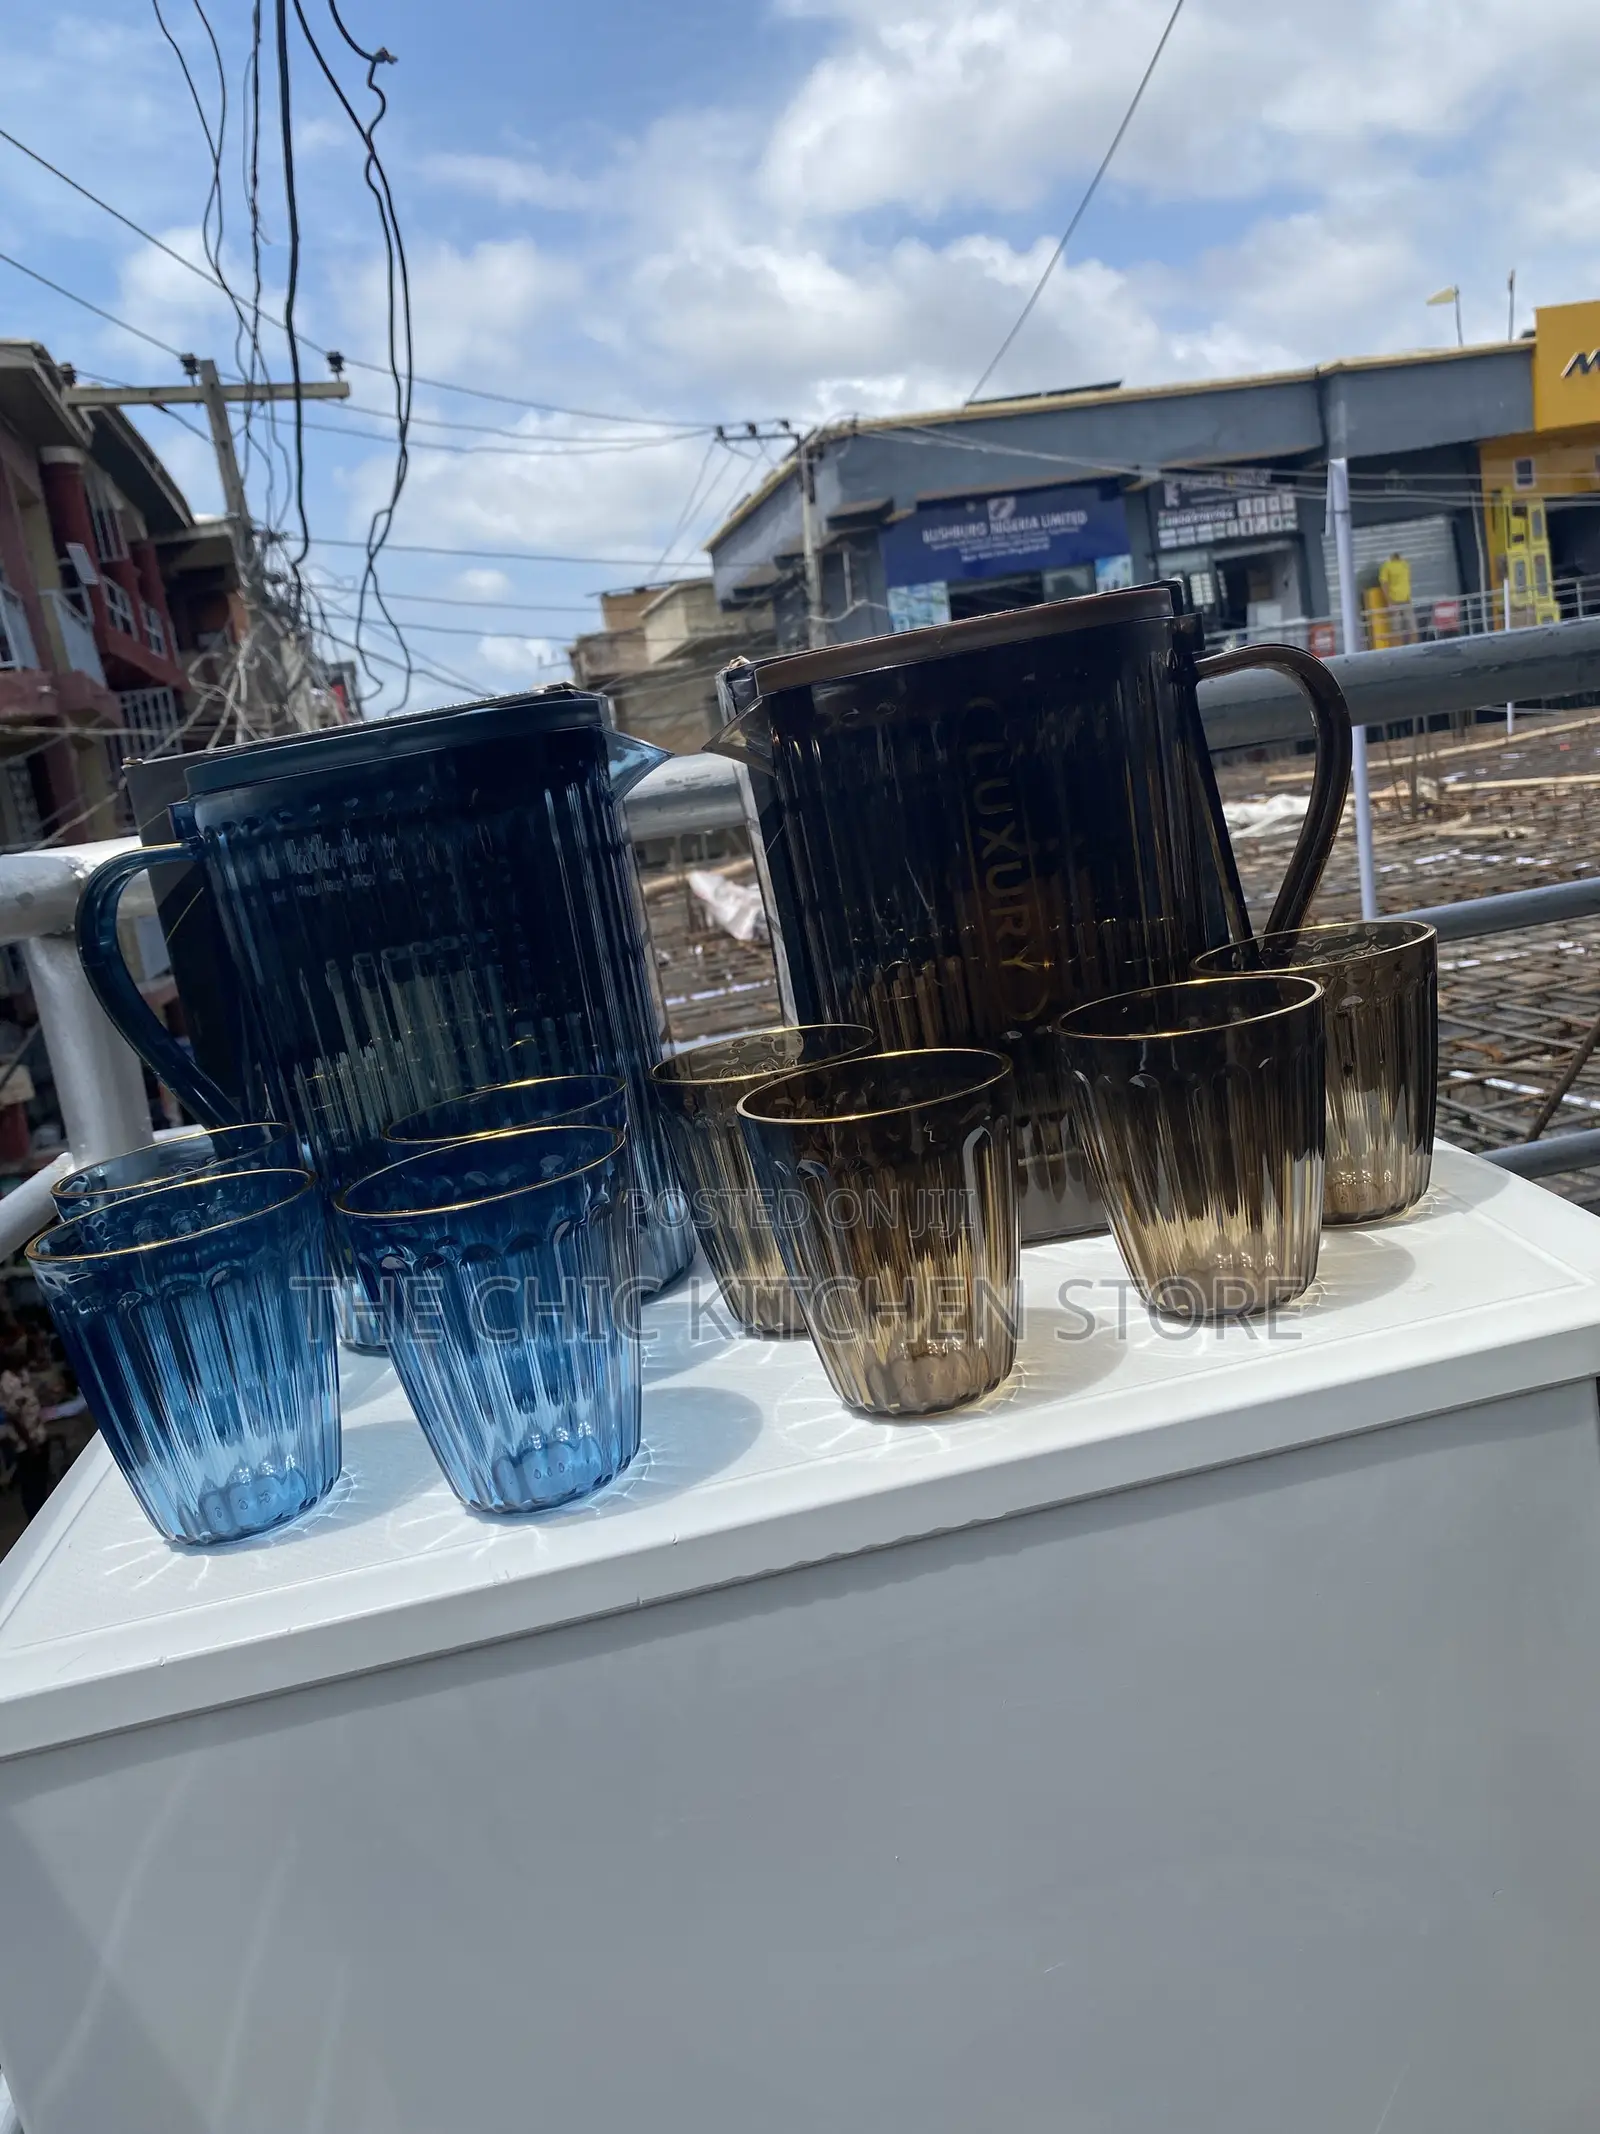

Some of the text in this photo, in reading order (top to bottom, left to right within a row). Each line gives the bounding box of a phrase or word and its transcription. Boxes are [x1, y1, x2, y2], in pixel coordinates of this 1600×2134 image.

[990, 514, 1040, 536] NIGERIA
[1041, 509, 1088, 528] LIMITED
[966, 742, 1042, 976] LUXURY
